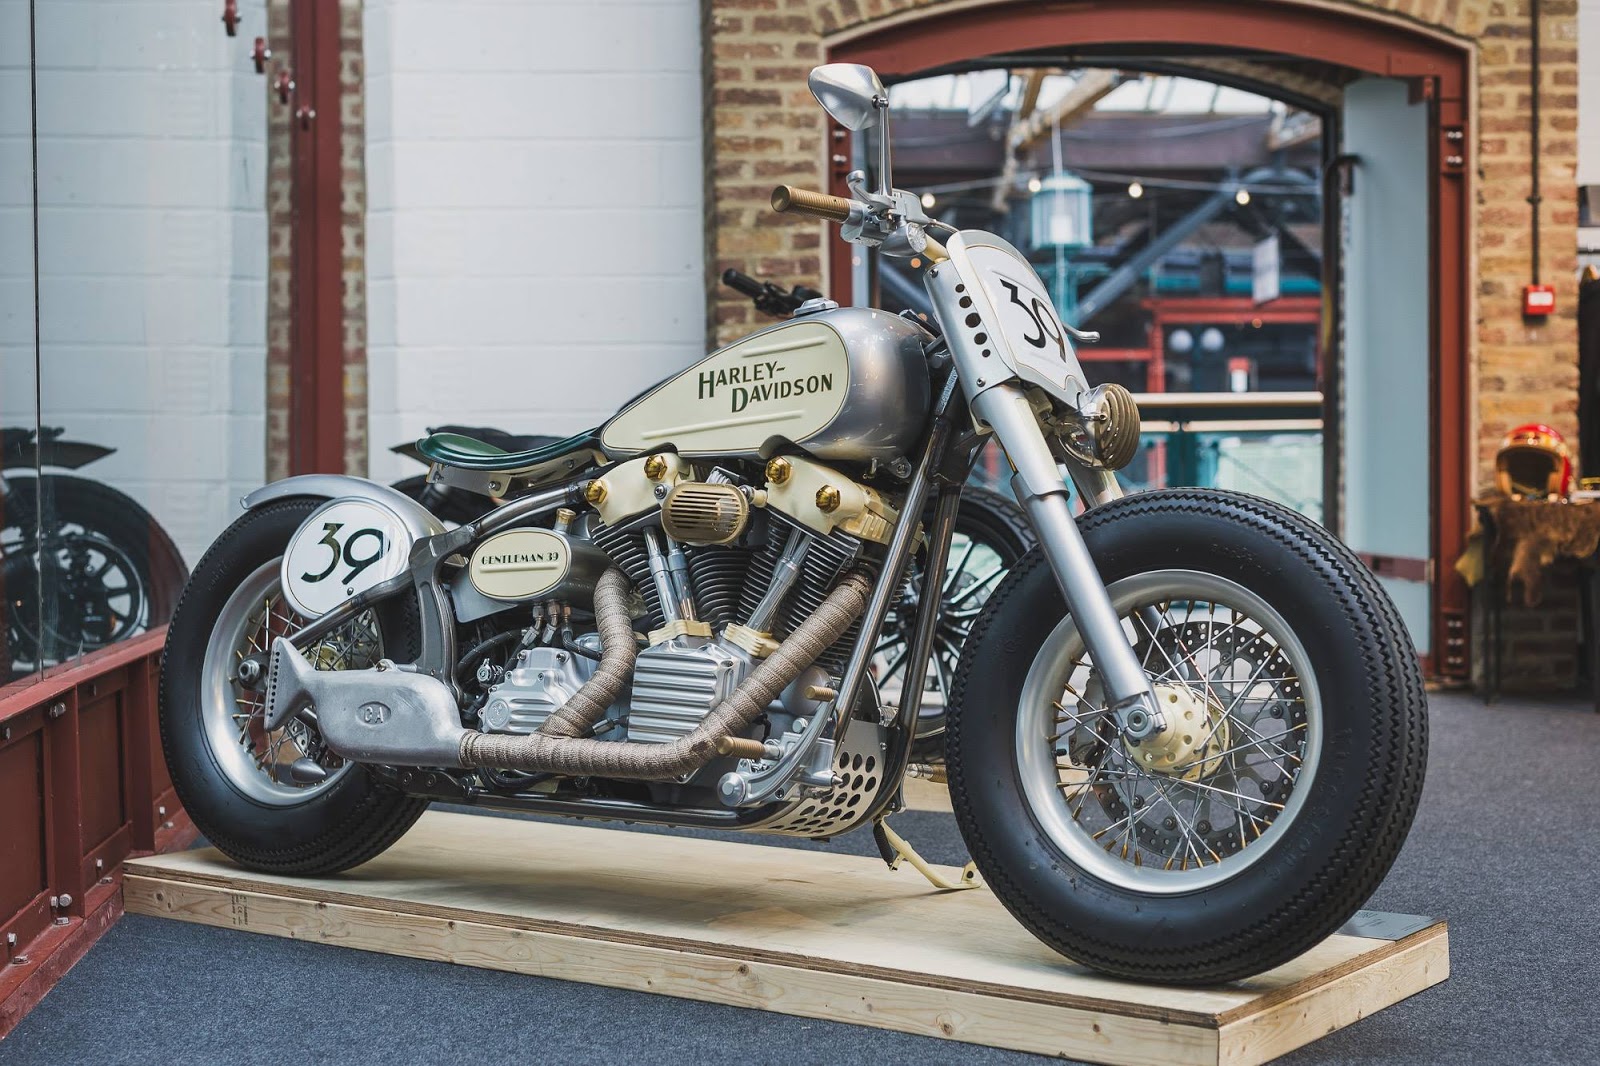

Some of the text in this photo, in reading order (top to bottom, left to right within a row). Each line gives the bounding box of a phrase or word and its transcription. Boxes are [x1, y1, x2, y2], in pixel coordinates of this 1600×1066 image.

[999, 277, 1067, 364] 39
[698, 361, 786, 400] HARLEY-
[731, 373, 833, 413] DAVIDSON
[300, 522, 391, 586] 39
[481, 551, 559, 565] GENTLEMAN 39
